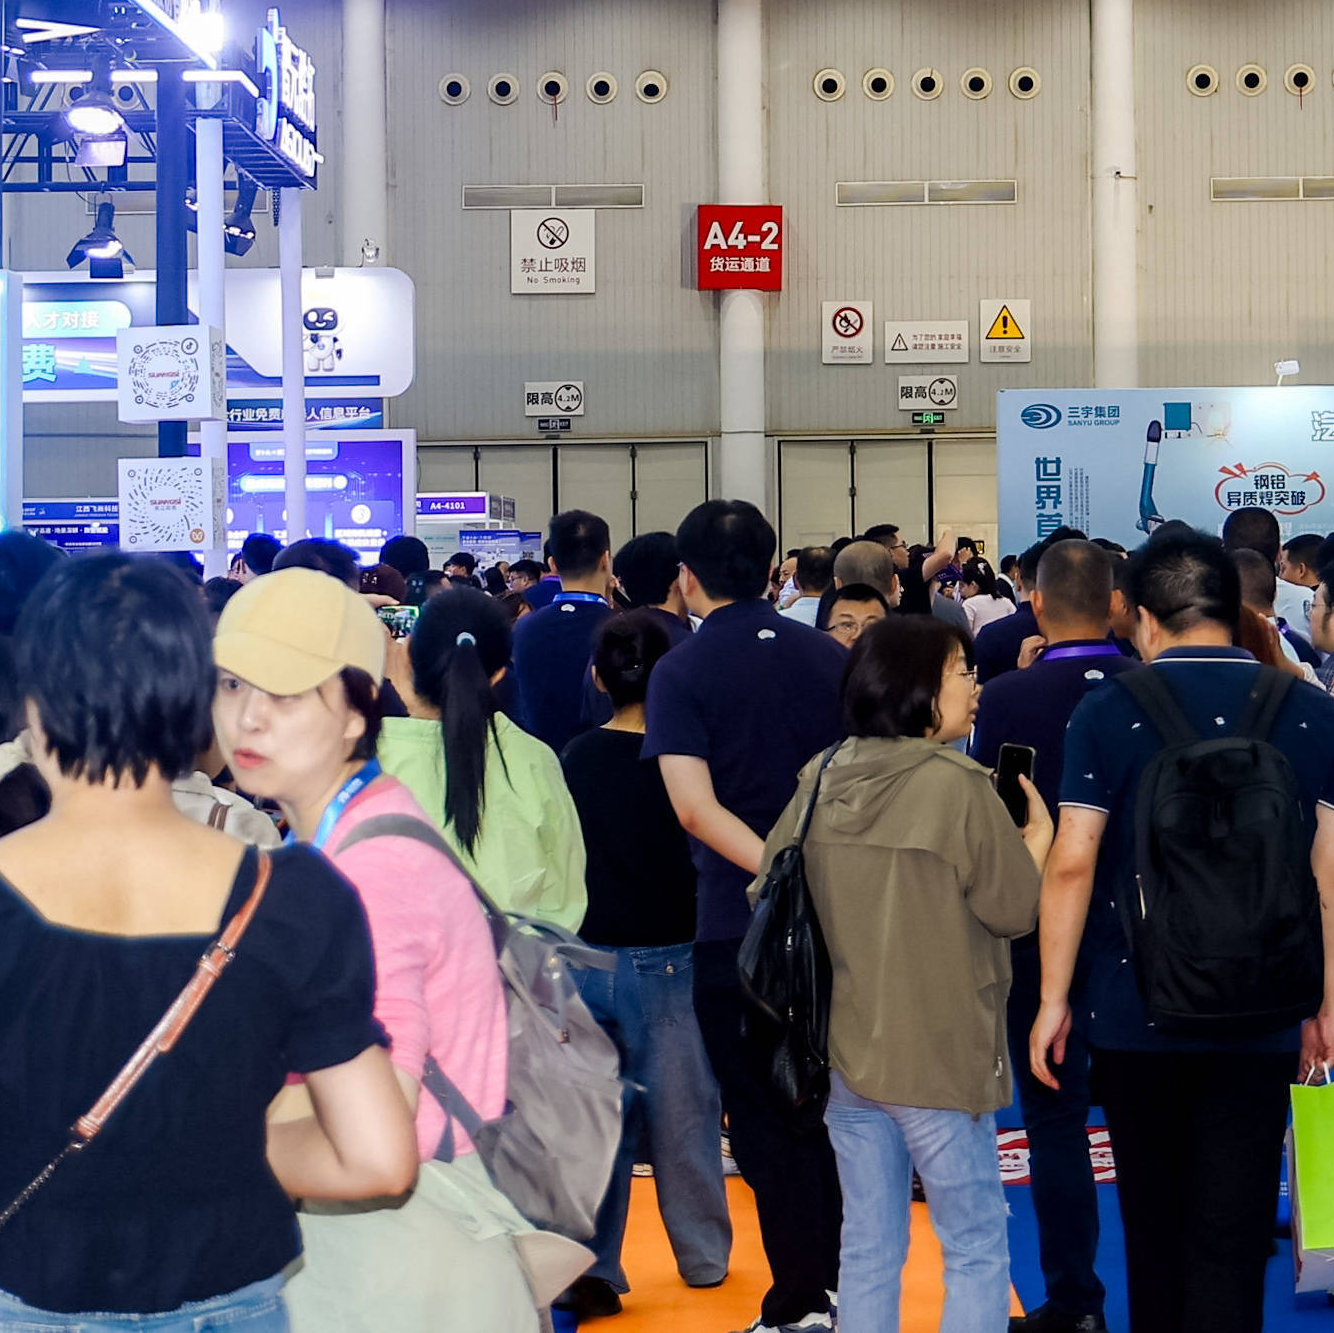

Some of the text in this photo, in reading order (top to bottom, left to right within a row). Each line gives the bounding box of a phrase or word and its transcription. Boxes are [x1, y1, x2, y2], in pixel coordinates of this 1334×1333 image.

[704, 221, 779, 250] A4-2
[521, 257, 586, 273] 禁止吸烟
[710, 257, 771, 272] 货运通道
[543, 276, 581, 285] Smoking
[831, 345, 864, 354] 严禁烟火
[989, 345, 1022, 354] 注意安全
[526, 392, 555, 406] 限高
[900, 385, 927, 400] 限高
[227, 406, 372, 422] 行业免费人信息平台
[1068, 406, 1121, 419] 三宇集团
[1068, 419, 1120, 427] SANYU GROUP
[1253, 474, 1286, 491] 钢铝
[430, 502, 466, 510] A4-4101
[1035, 456, 1063, 542] 世界首
[1226, 490, 1307, 507] 异质焊突破
